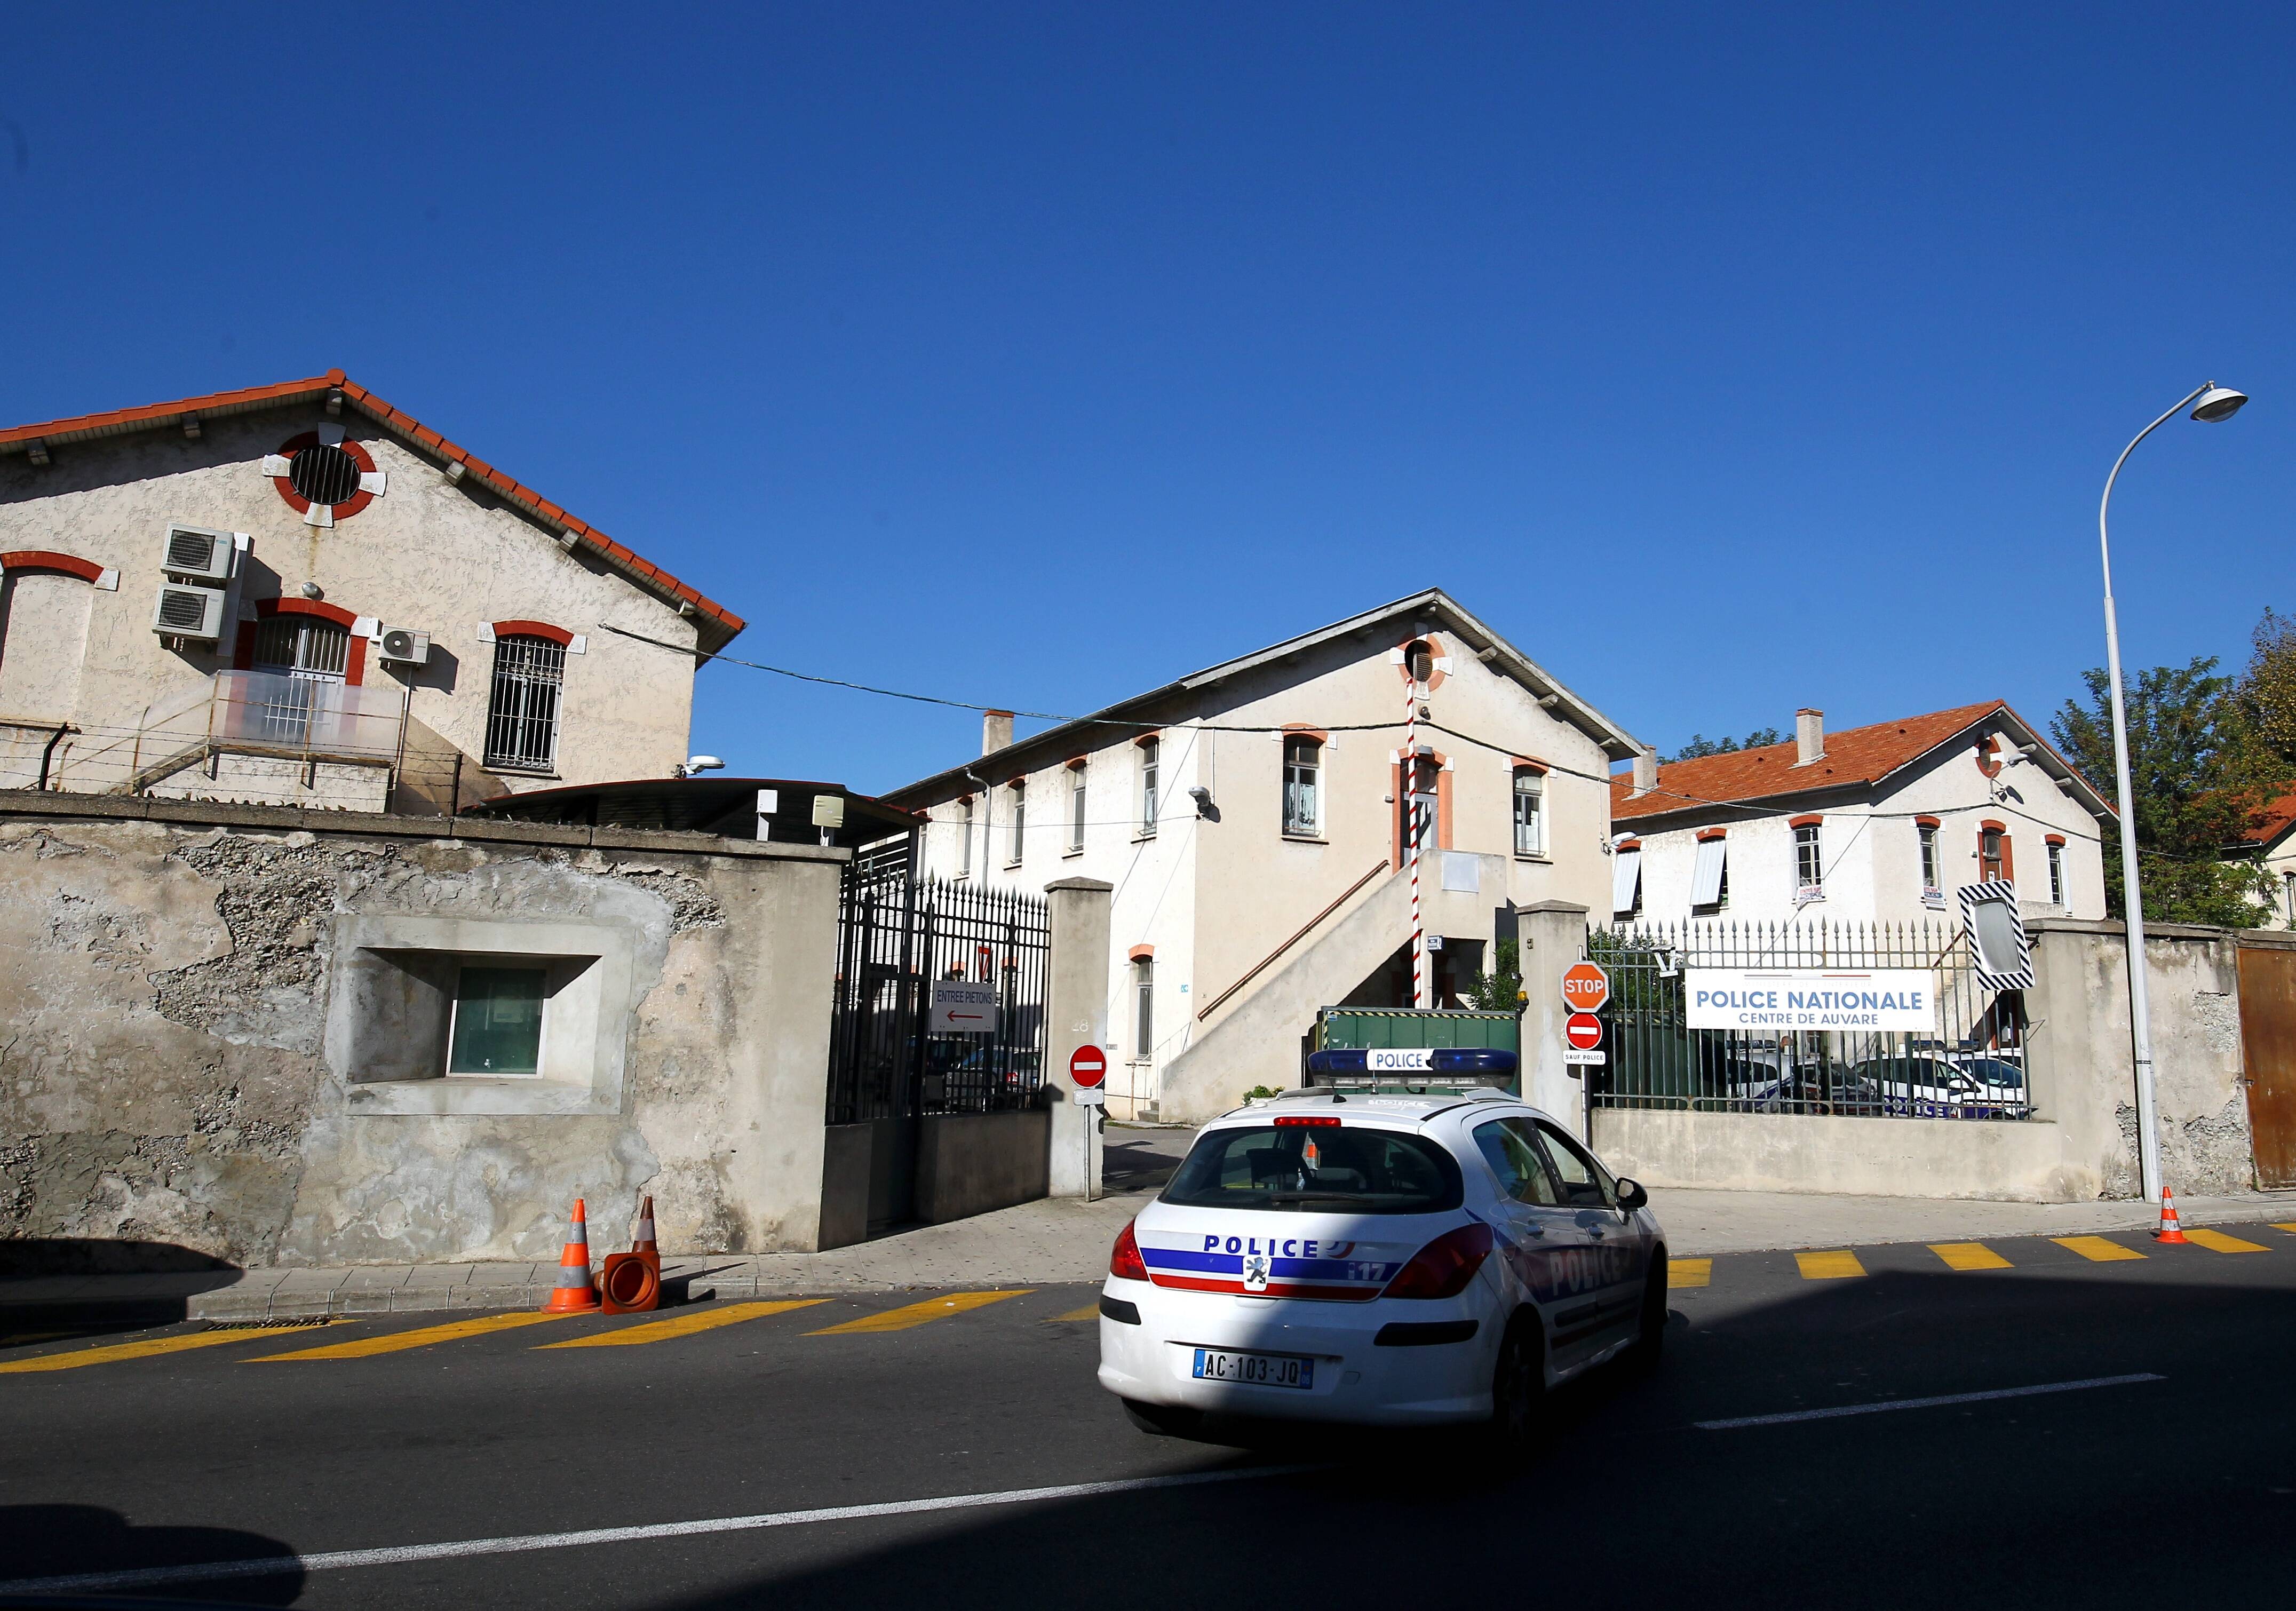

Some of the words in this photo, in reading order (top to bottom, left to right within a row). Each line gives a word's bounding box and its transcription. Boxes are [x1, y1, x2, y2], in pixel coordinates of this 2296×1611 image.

[1565, 979, 1604, 994] STOP
[937, 990, 964, 1003] ENTREE
[965, 991, 992, 1004] PIETONS
[1697, 990, 1778, 1009] POLICE
[1787, 991, 1922, 1010] NATIONALE
[1739, 1013, 1792, 1023] CENTRE
[1798, 1013, 1815, 1023] DE
[1821, 1014, 1878, 1025] AUVARE
[1377, 1053, 1423, 1068] POLICE
[1204, 1235, 1318, 1258] POLICE
[1358, 1263, 1386, 1280] 17
[1550, 1247, 1621, 1296] POLICE
[1205, 1354, 1298, 1384] AC-103-JQ
